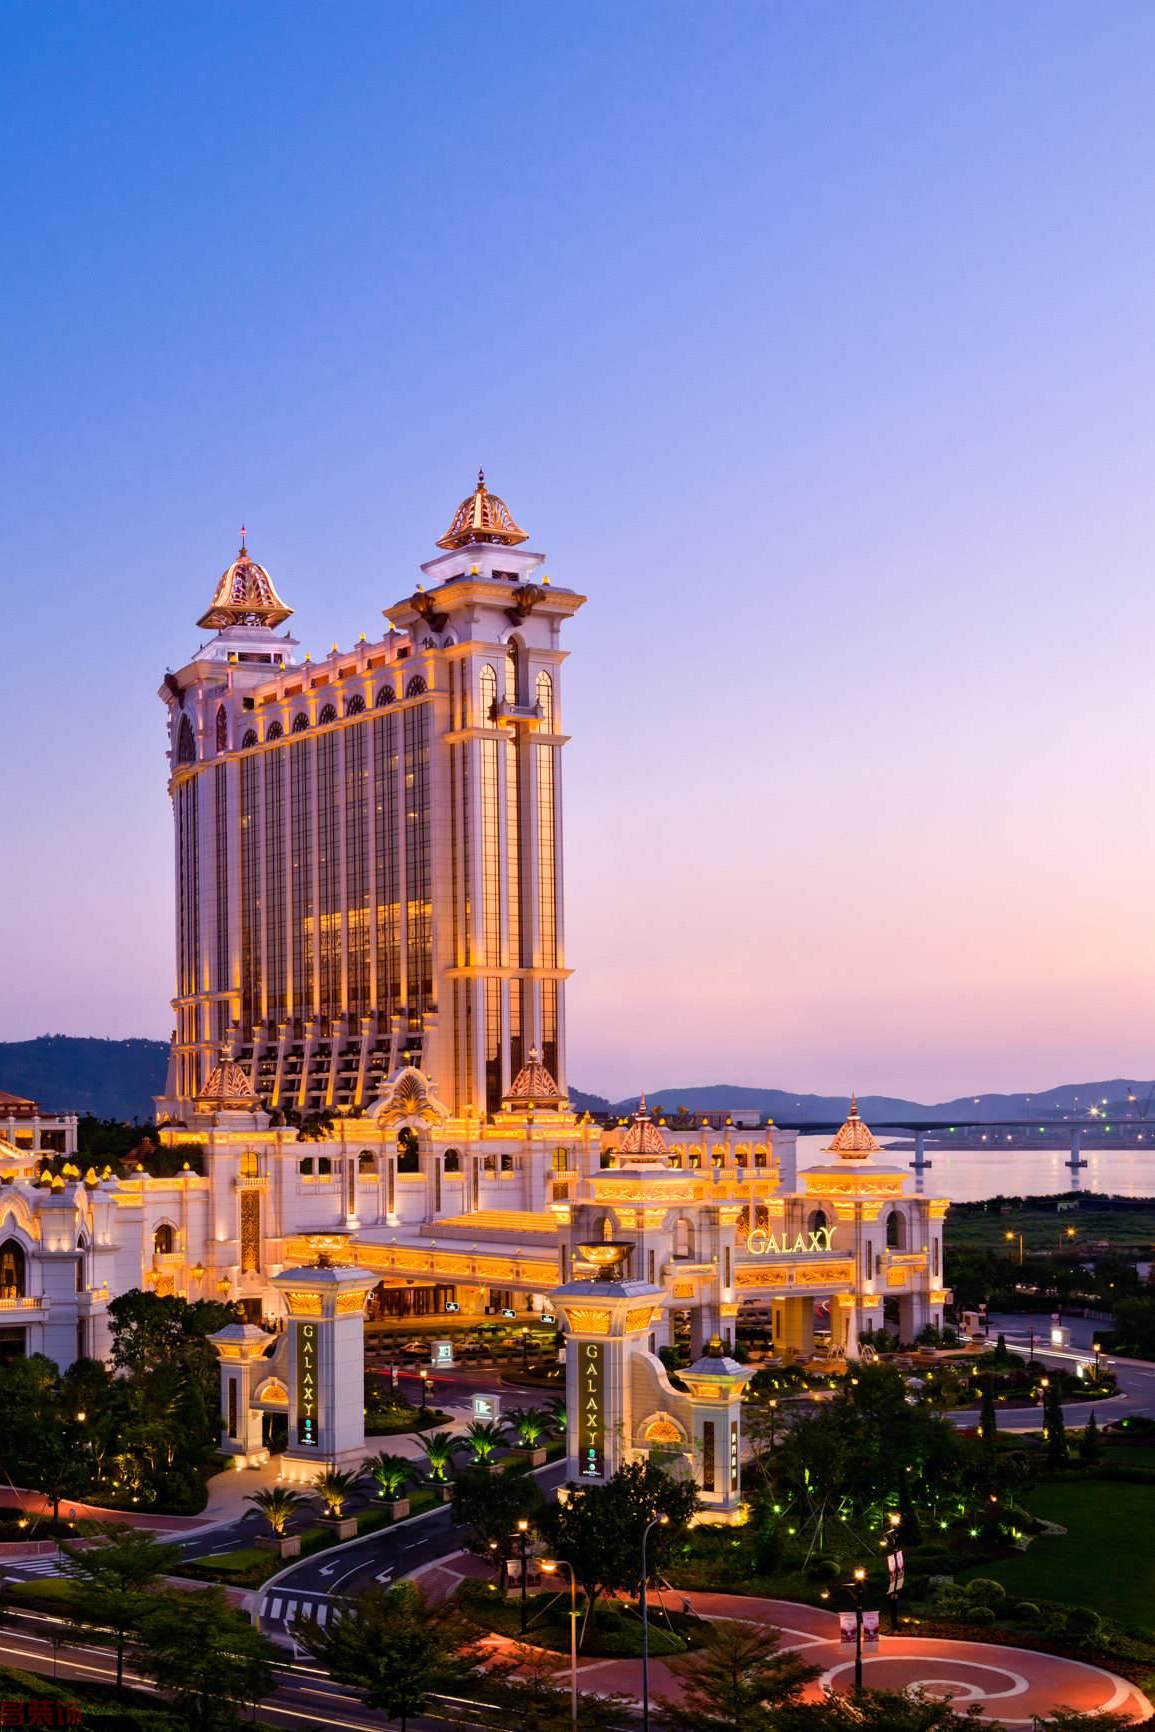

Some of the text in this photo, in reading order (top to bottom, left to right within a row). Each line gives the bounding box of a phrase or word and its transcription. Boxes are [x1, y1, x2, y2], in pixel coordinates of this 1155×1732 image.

[747, 1226, 837, 1254] GALAXY
[303, 1325, 314, 1416] GALAXY
[586, 1344, 598, 1445] GALAXY
